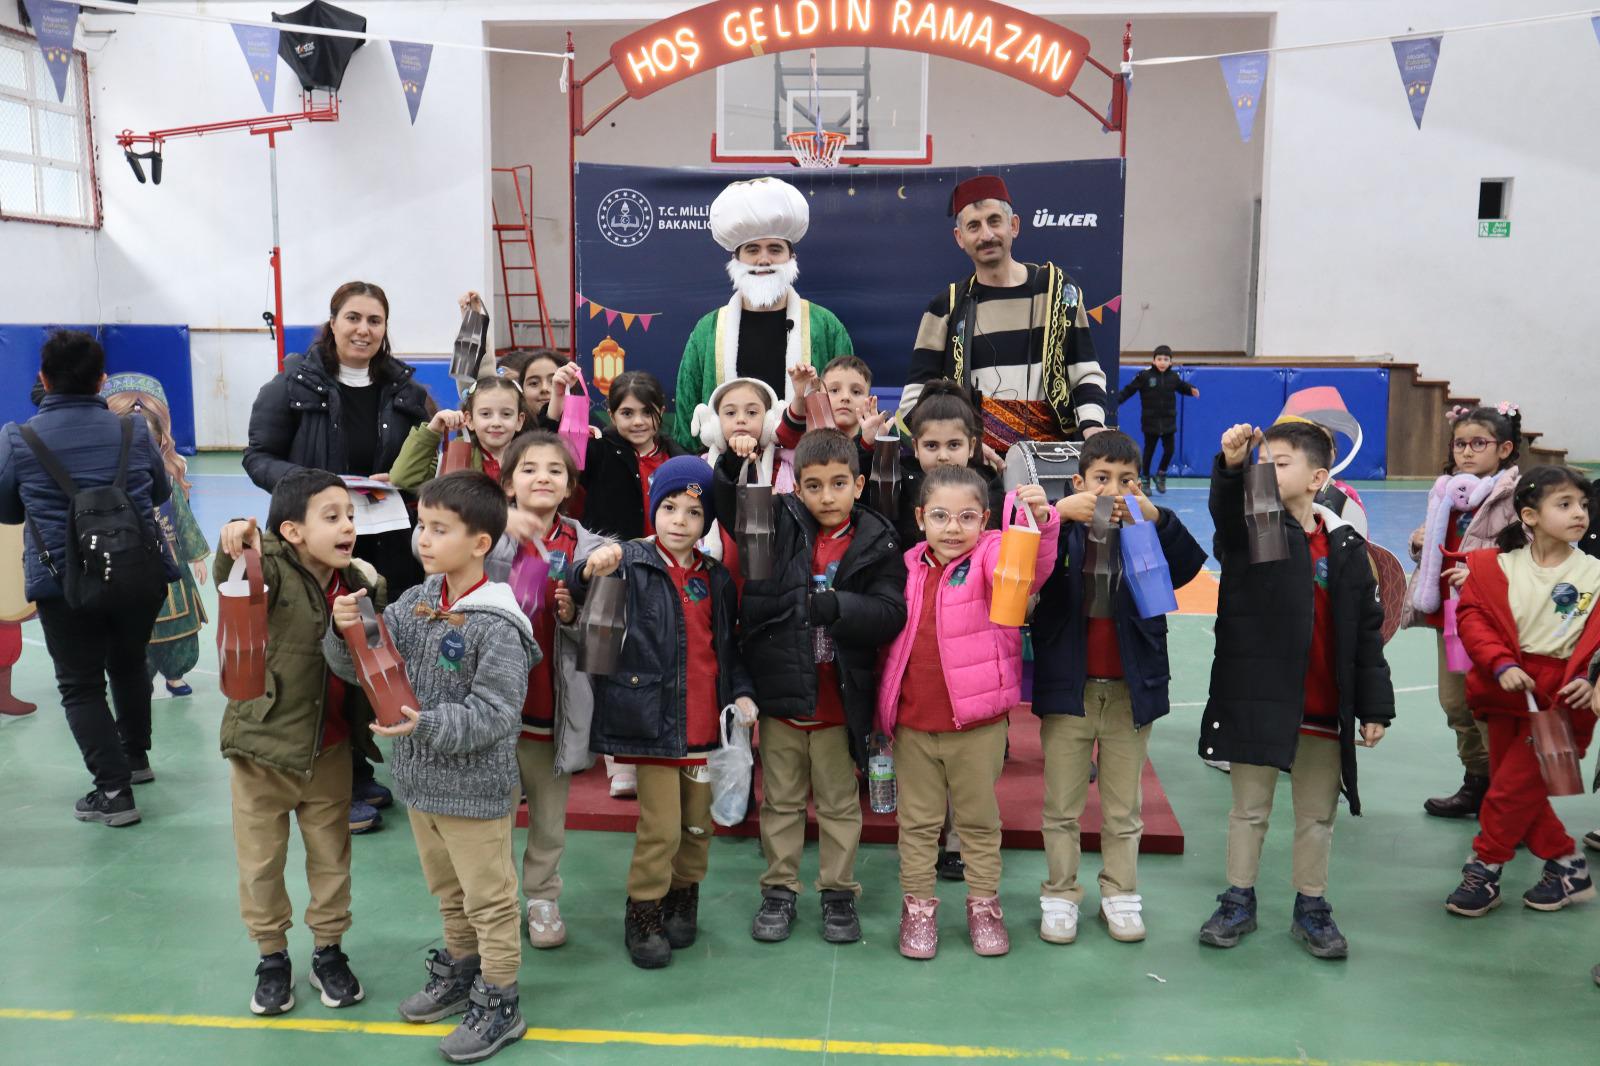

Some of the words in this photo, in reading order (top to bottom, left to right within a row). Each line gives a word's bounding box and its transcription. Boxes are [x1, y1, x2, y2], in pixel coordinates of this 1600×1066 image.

[626, 27, 700, 84] HOŞ
[891, 0, 1072, 81] RAMAZAN
[658, 206, 678, 217] T.C.
[1032, 208, 1098, 228] ÜLKER
